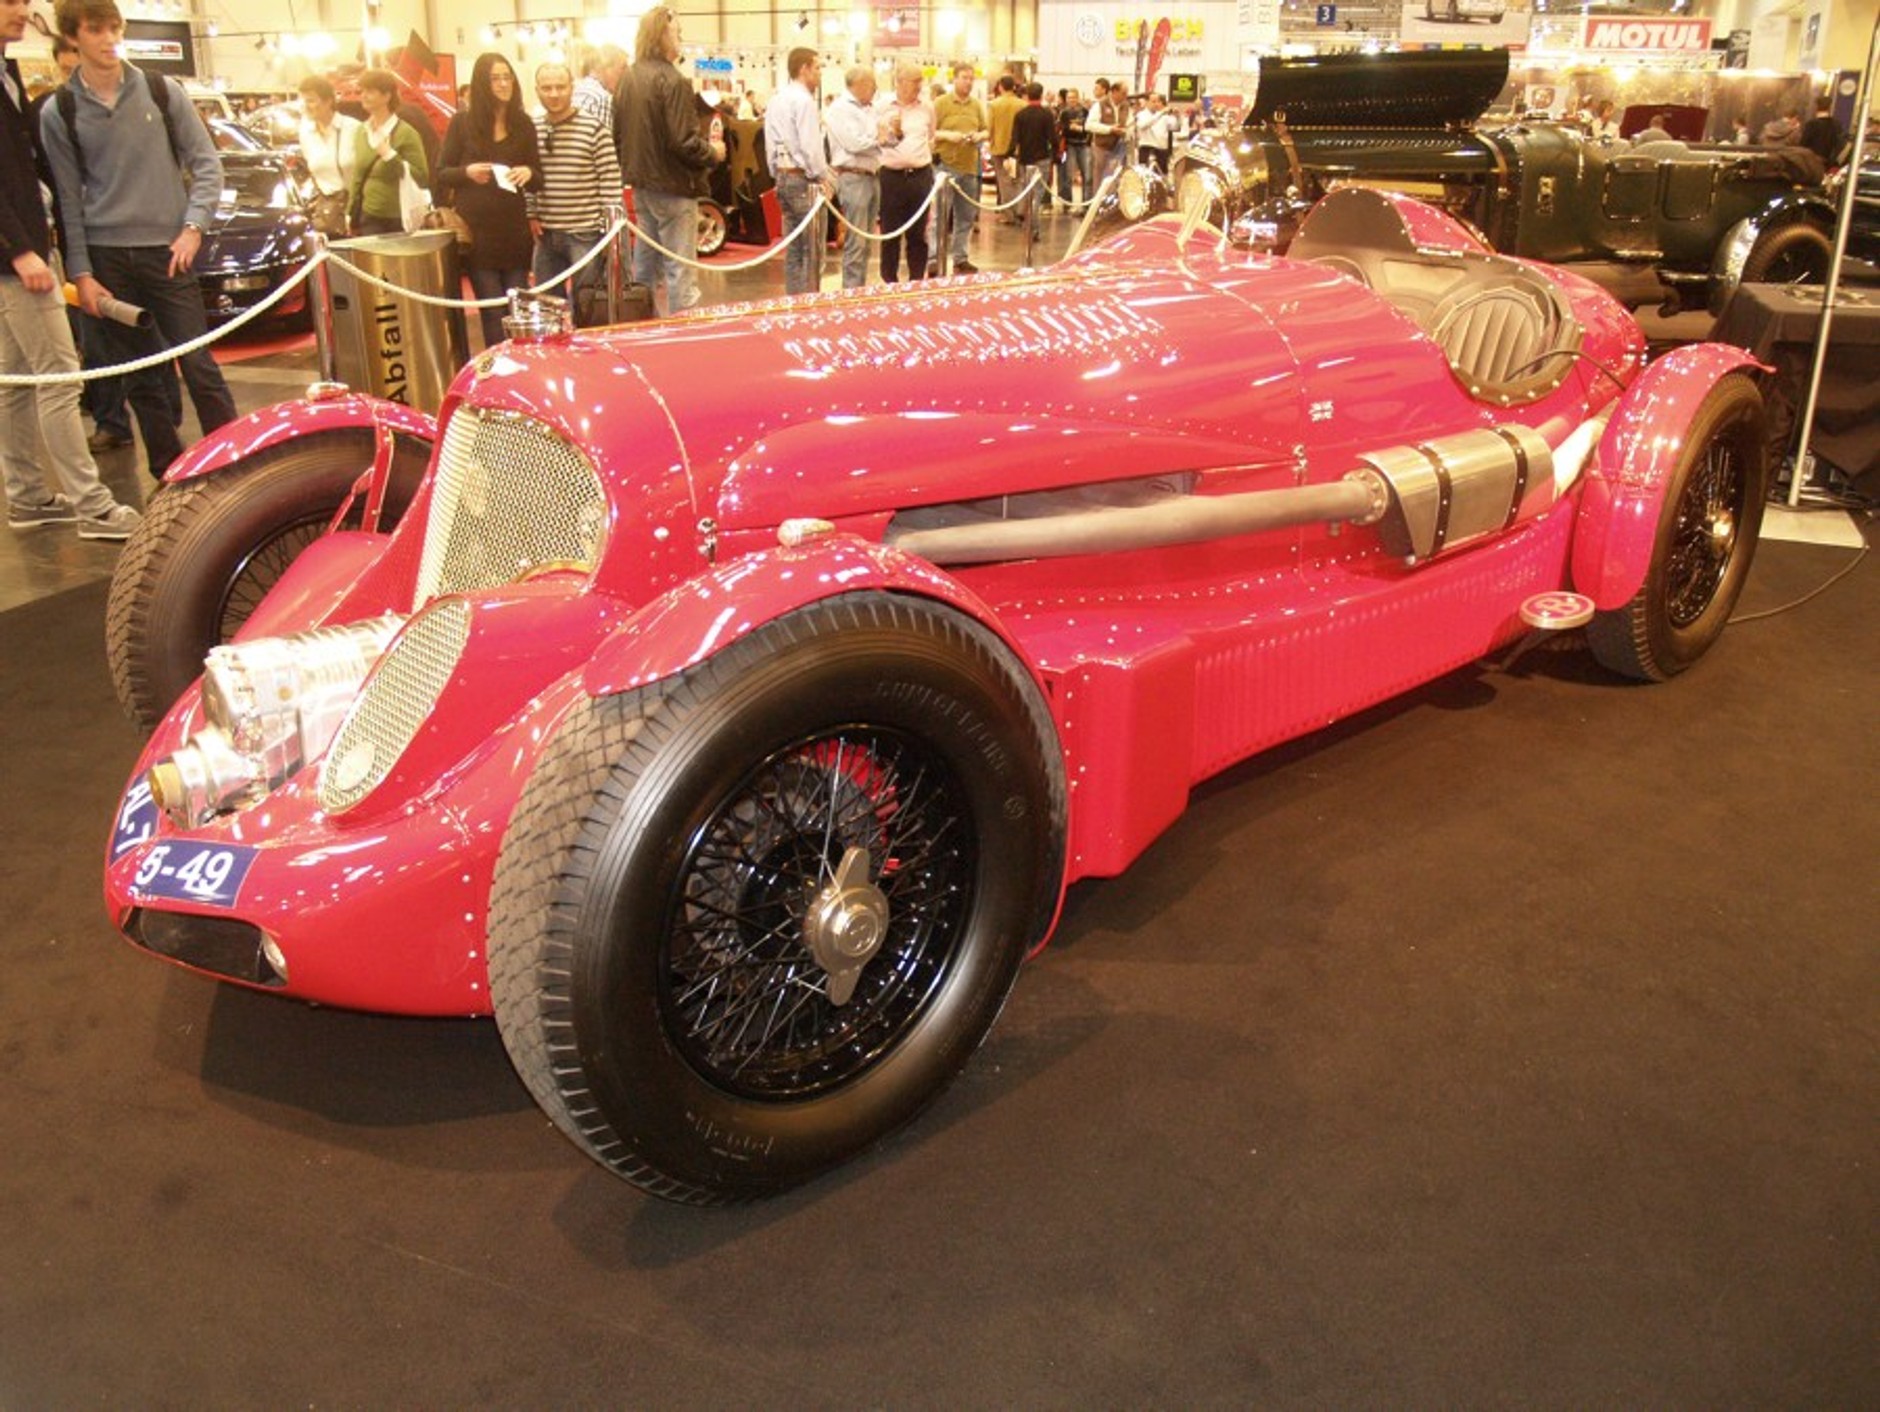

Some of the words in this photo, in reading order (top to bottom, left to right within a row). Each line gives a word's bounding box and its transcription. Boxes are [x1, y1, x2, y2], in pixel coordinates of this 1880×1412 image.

[1321, 6, 1330, 21] 3
[1590, 23, 1703, 48] MOTUL
[374, 304, 410, 406] Abfall
[134, 845, 234, 894] 5-49
